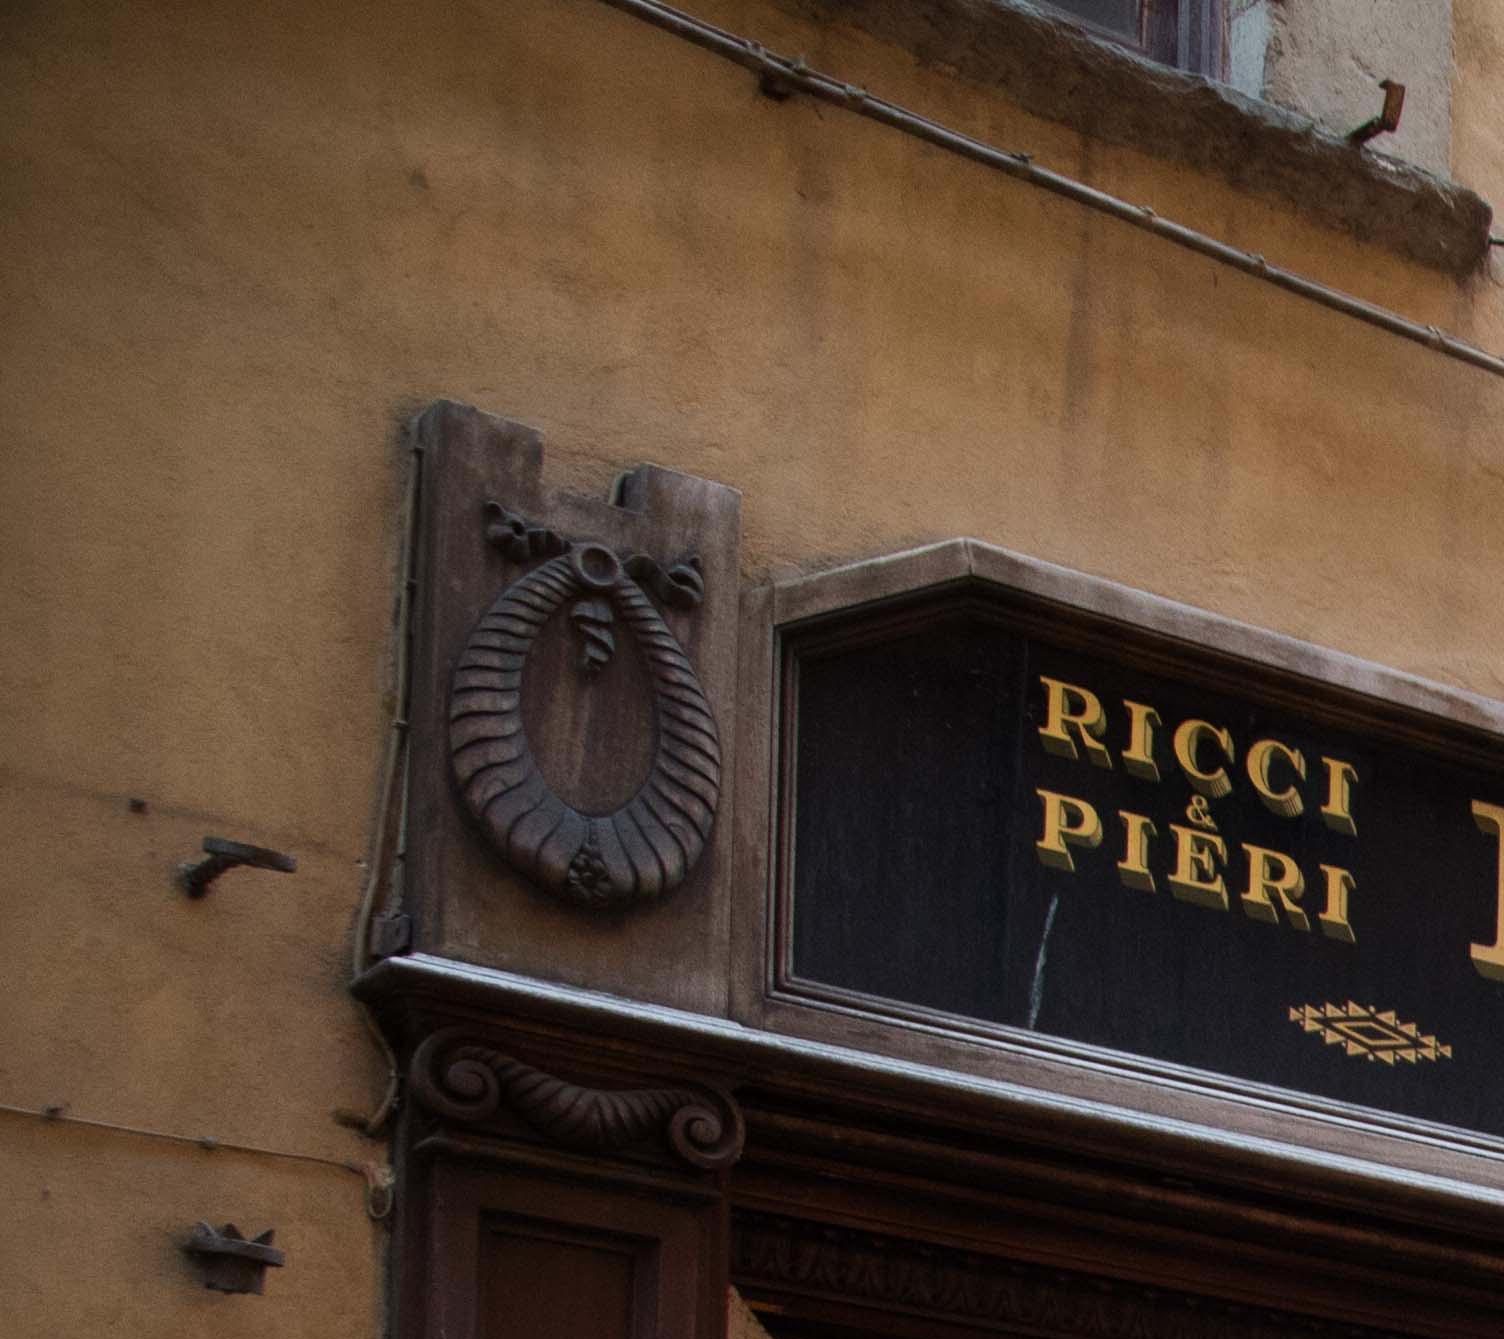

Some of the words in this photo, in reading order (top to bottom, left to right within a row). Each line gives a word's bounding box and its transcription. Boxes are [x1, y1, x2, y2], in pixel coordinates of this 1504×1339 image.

[1039, 675, 1358, 836] RICCI
[1187, 794, 1217, 831] &
[1036, 789, 1356, 943] PIERI
